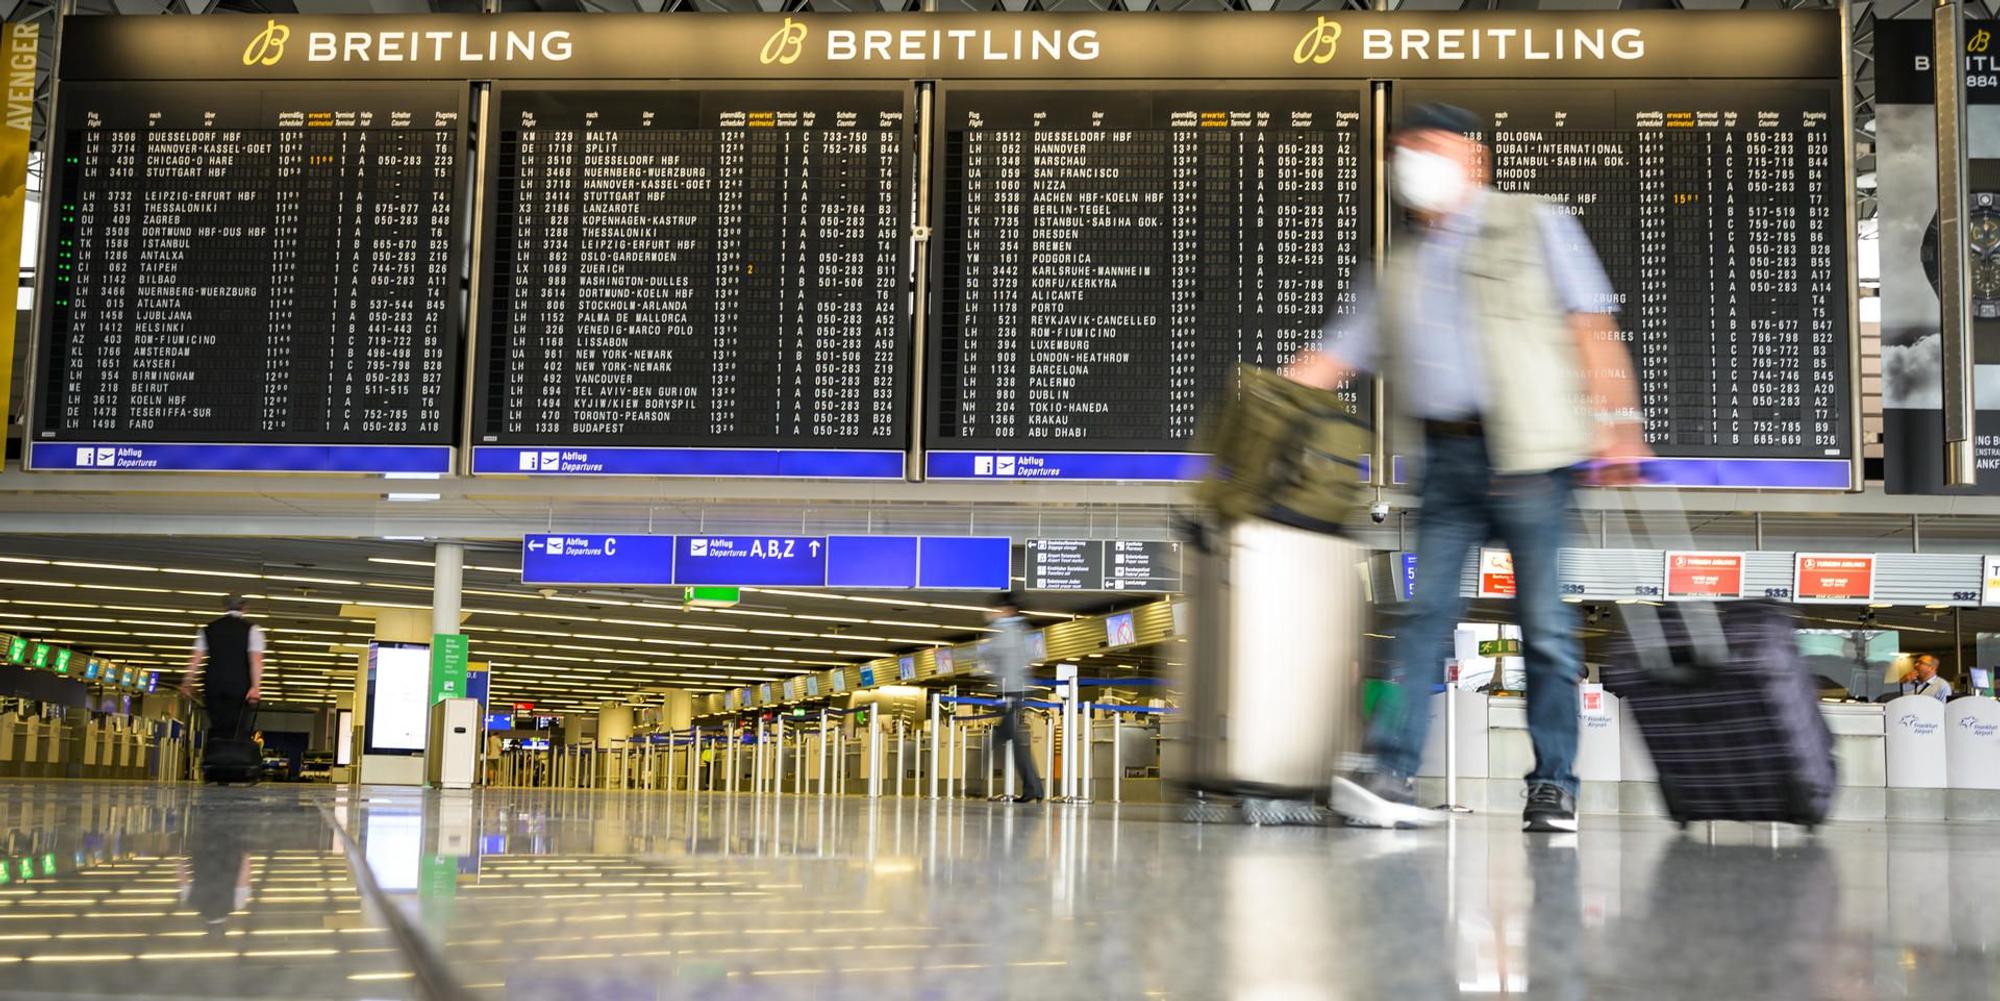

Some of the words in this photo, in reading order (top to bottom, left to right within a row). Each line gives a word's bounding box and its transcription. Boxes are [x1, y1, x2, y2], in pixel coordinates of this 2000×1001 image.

[309, 31, 572, 62] BREITLING
[828, 30, 1099, 61] BREITLING
[1364, 29, 1644, 60] BREITLING
[6, 23, 39, 131] AVENGER
[1966, 75, 1998, 87] 884
[149, 132, 215, 141] DUESSELDORF
[223, 132, 240, 141] HBF
[586, 132, 617, 141] MALTA
[1035, 132, 1105, 141] DUESSELDORF
[1113, 132, 1131, 141] HBF
[1496, 132, 1542, 141] BOLOGNA
[148, 144, 271, 153] HANNOVER-KASSEL-GOET
[586, 144, 616, 153] SPLIT
[1035, 144, 1086, 153] HANNOVER
[1496, 144, 1622, 153] DUBAI-INTERNATIONAL
[209, 156, 233, 165] HARE
[585, 156, 653, 165] DUESSELDORF
[661, 156, 679, 165] HBF
[1034, 156, 1086, 165] WARSCHAU
[1498, 157, 1596, 166] ISTANBUL-SABIHA
[147, 168, 201, 177] STUTTGART
[208, 168, 225, 177] HBF
[584, 168, 705, 177] NUERNBERG-WUERZBURG
[1034, 168, 1053, 178] SAN
[1060, 168, 1118, 178] FRANCISCO
[1497, 169, 1536, 178] RHODOS
[584, 180, 710, 189] HANNOVER-KASSEL-GOET
[1034, 180, 1066, 190] NIZZA
[1498, 182, 1529, 190] TURIN
[145, 191, 231, 200] LEIPZIG-ERFURT
[238, 191, 255, 200] HBF
[584, 191, 640, 201] STUTTGART
[647, 192, 665, 201] HBF
[1034, 193, 1072, 202] AACHEN
[1079, 193, 1138, 202] HBF-KOELN
[1145, 193, 1163, 202] HBF
[1578, 194, 1596, 202] HBF
[145, 203, 217, 212] THESSALONIKI
[583, 204, 639, 213] LANZAROTE
[1033, 205, 1110, 214] BERLIN-TEGEL
[1749, 207, 1794, 216] 517-519
[1810, 208, 1828, 216] B12
[143, 215, 180, 224] ZAGREB
[583, 216, 697, 225] KOPENHAGEN-KASTRUP
[1035, 217, 1131, 226] ISTANBUL-SABIHA
[142, 227, 191, 236] DORTMUND
[248, 227, 265, 236] HBF
[583, 228, 656, 237] THESSALONIKI
[1033, 229, 1078, 239] DRESDEN
[143, 239, 190, 248] ISTANBUL
[582, 240, 670, 249] LEIPZIG-ERFURT
[677, 240, 695, 249] HBF
[1033, 241, 1071, 251] BREMEN
[581, 252, 676, 261] OSLO-GARDERMOEN
[1032, 254, 1091, 263] PODGORICA
[141, 263, 177, 272] TAIPEH
[580, 264, 624, 273] ZUERICH
[1032, 266, 1150, 275] KARLSRUHE-MANNHEIM
[139, 275, 176, 284] BILBAO
[580, 277, 688, 286] WASHINGTON-DULLES
[1032, 278, 1117, 288] KORFU/KERKYRA
[138, 287, 256, 296] NUERNBERG-WUERZBURG
[579, 289, 668, 298] DORTMUND-KOELN
[675, 289, 693, 298] HBF
[1032, 291, 1083, 300] ALICANTE
[137, 299, 180, 308] ATLANTA
[579, 301, 687, 310] STOCKHOLM-ARLANDA
[1031, 303, 1064, 312] PORTO
[137, 311, 192, 320] LJUBLJANA
[578, 313, 609, 322] PALMA
[616, 313, 628, 322] DE
[636, 313, 687, 323] MALLORCA
[1031, 316, 1156, 325] REYKJAVIK-CANCELLED
[135, 323, 184, 332] HELSINKI
[578, 325, 660, 334] VENEDIG-MARCO
[668, 325, 693, 335] POLO
[1813, 321, 1832, 330] B47
[1031, 328, 1116, 337] ROM-FIUMICINO
[135, 335, 216, 344] ROM-FIUMICINO
[577, 337, 628, 347] LISSABON
[1031, 340, 1089, 350] LUXEMBURG
[134, 347, 190, 356] AMSTERDAM
[576, 350, 595, 359] NEW
[603, 350, 672, 359] YORK-NEWARK
[1031, 353, 1129, 362] LONDON-HEATHROW
[133, 359, 175, 368] KAYSERI
[576, 362, 595, 371] NEW
[602, 362, 671, 371] YORK-NEWARK
[1030, 365, 1088, 374] BARCELONA
[132, 371, 194, 380] BIRMINGHAM
[575, 374, 632, 383] VANCOUVER
[1753, 371, 1798, 380] 744-746
[1814, 372, 1833, 380] B45
[1030, 377, 1075, 387] PALERMO
[131, 383, 168, 392] BEIRUT
[575, 386, 592, 396] TEL
[600, 387, 651, 396] AVIV-BEN
[658, 387, 697, 396] GURION
[1029, 390, 1069, 399] DUBLIN
[131, 395, 162, 405] KOELN
[168, 396, 186, 405] HBF
[645, 399, 695, 409] BORYSPIL
[1030, 403, 1108, 412] TOKIO-HANEDA
[574, 411, 670, 421] TORONTO-PEARSON
[1029, 415, 1068, 424] KRAKAU
[129, 419, 154, 429] FARO
[573, 423, 623, 433] BUDAPEST
[1754, 422, 1800, 431] 752-785
[1028, 427, 1048, 437] ABU
[1055, 428, 1086, 437] DHABI
[118, 448, 142, 457] Abflug
[562, 452, 587, 461] Abflug
[117, 458, 157, 467] Departures
[1018, 456, 1043, 466] Abflug
[1976, 458, 2000, 469] ANKF
[562, 462, 602, 472] Departures
[1018, 467, 1060, 476] Departures
[566, 537, 588, 547] Abflug
[605, 538, 616, 555] C
[710, 539, 733, 548] Abflug
[750, 539, 795, 559] A,B,Z
[566, 547, 601, 556] Departures
[709, 548, 747, 557] Departures
[1765, 588, 1788, 598] 533
[1953, 592, 1977, 601] 532
